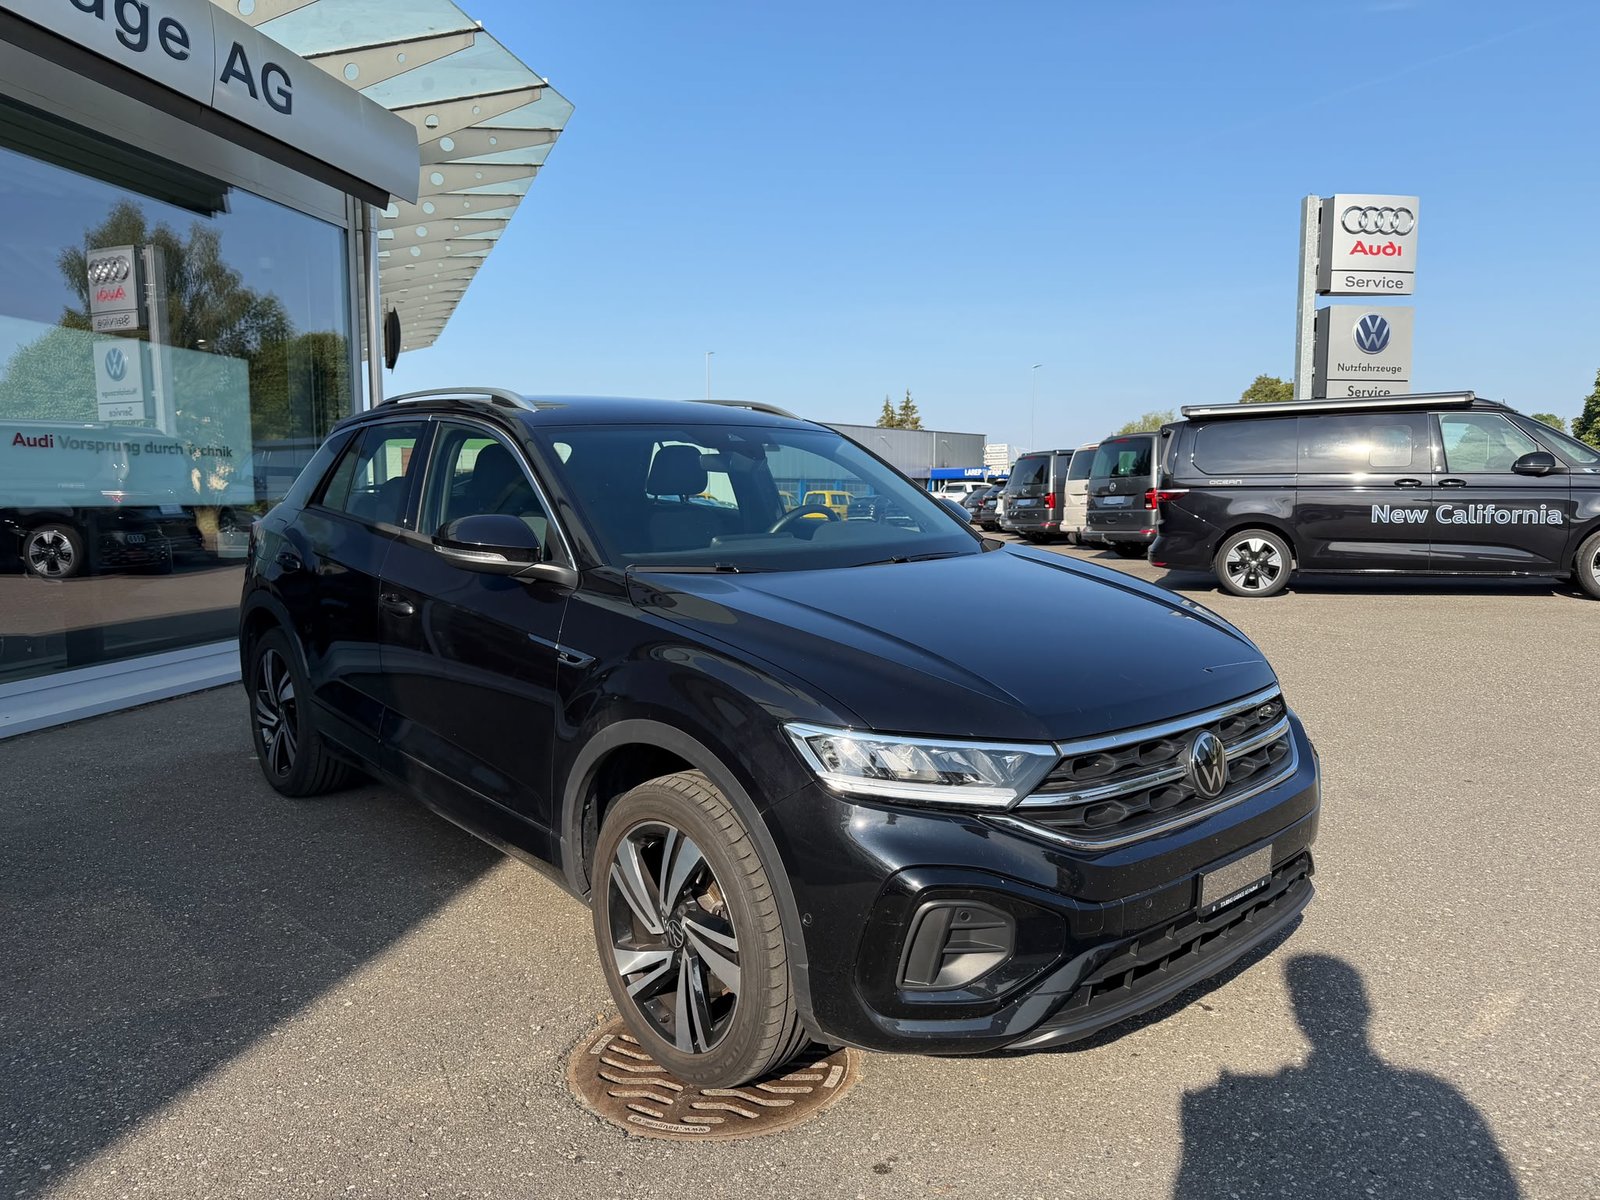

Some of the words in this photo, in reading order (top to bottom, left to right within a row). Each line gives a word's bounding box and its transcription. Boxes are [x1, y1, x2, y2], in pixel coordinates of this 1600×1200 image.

[219, 41, 292, 115] AG
[1349, 240, 1402, 257] Audi
[1345, 275, 1404, 289] Service
[1354, 314, 1391, 353] VW
[1337, 363, 1402, 375] Nutzfahrzeuge
[1347, 385, 1391, 398] Service
[12, 432, 54, 448] Audi
[58, 435, 141, 456] Vorsprung
[144, 441, 184, 455] durch
[1371, 504, 1429, 524] New
[1435, 504, 1563, 525] California
[1191, 731, 1227, 798] VW
